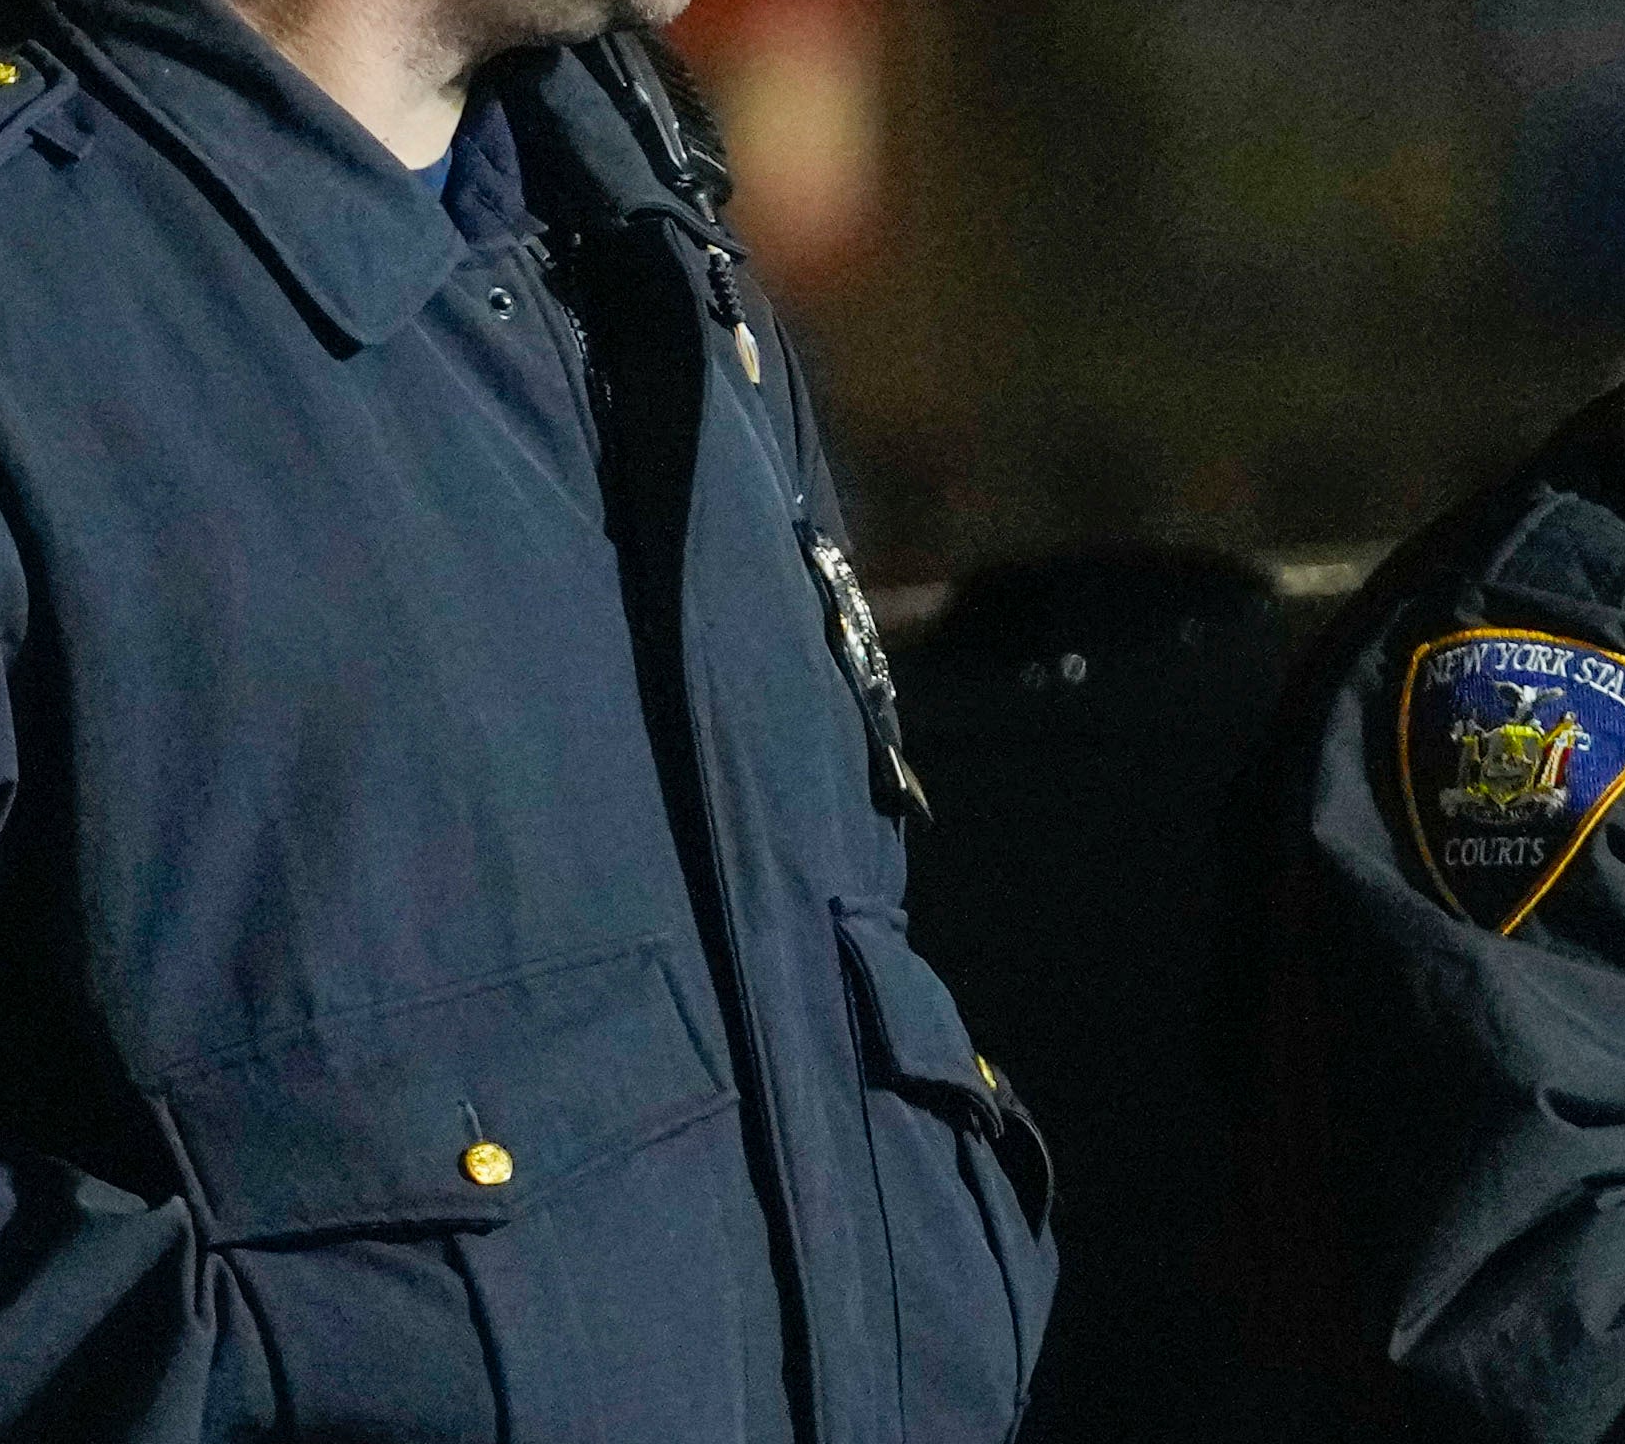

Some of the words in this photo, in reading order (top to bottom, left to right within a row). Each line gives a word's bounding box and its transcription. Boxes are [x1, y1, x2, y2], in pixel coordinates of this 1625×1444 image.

[1426, 643, 1487, 691] NEW
[1494, 642, 1574, 678] YORK
[1445, 836, 1545, 868] COURTS
